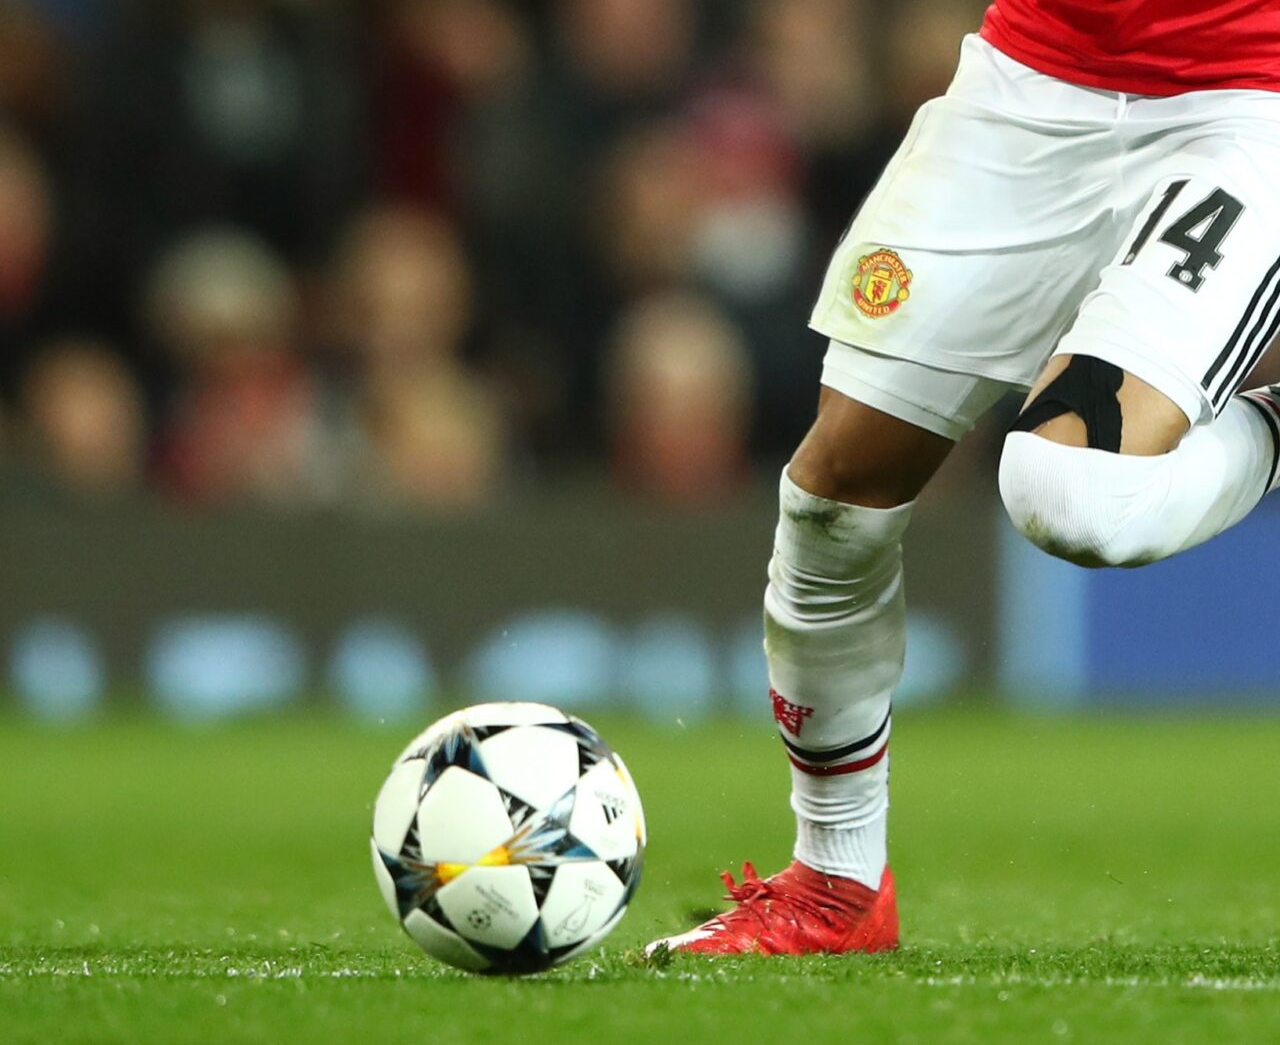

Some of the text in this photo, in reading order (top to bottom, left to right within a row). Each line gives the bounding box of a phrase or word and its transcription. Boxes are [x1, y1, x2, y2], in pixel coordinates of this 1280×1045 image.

[1119, 178, 1247, 294] 14
[861, 255, 908, 285] MANCHESTER
[857, 299, 891, 316] UNITED
